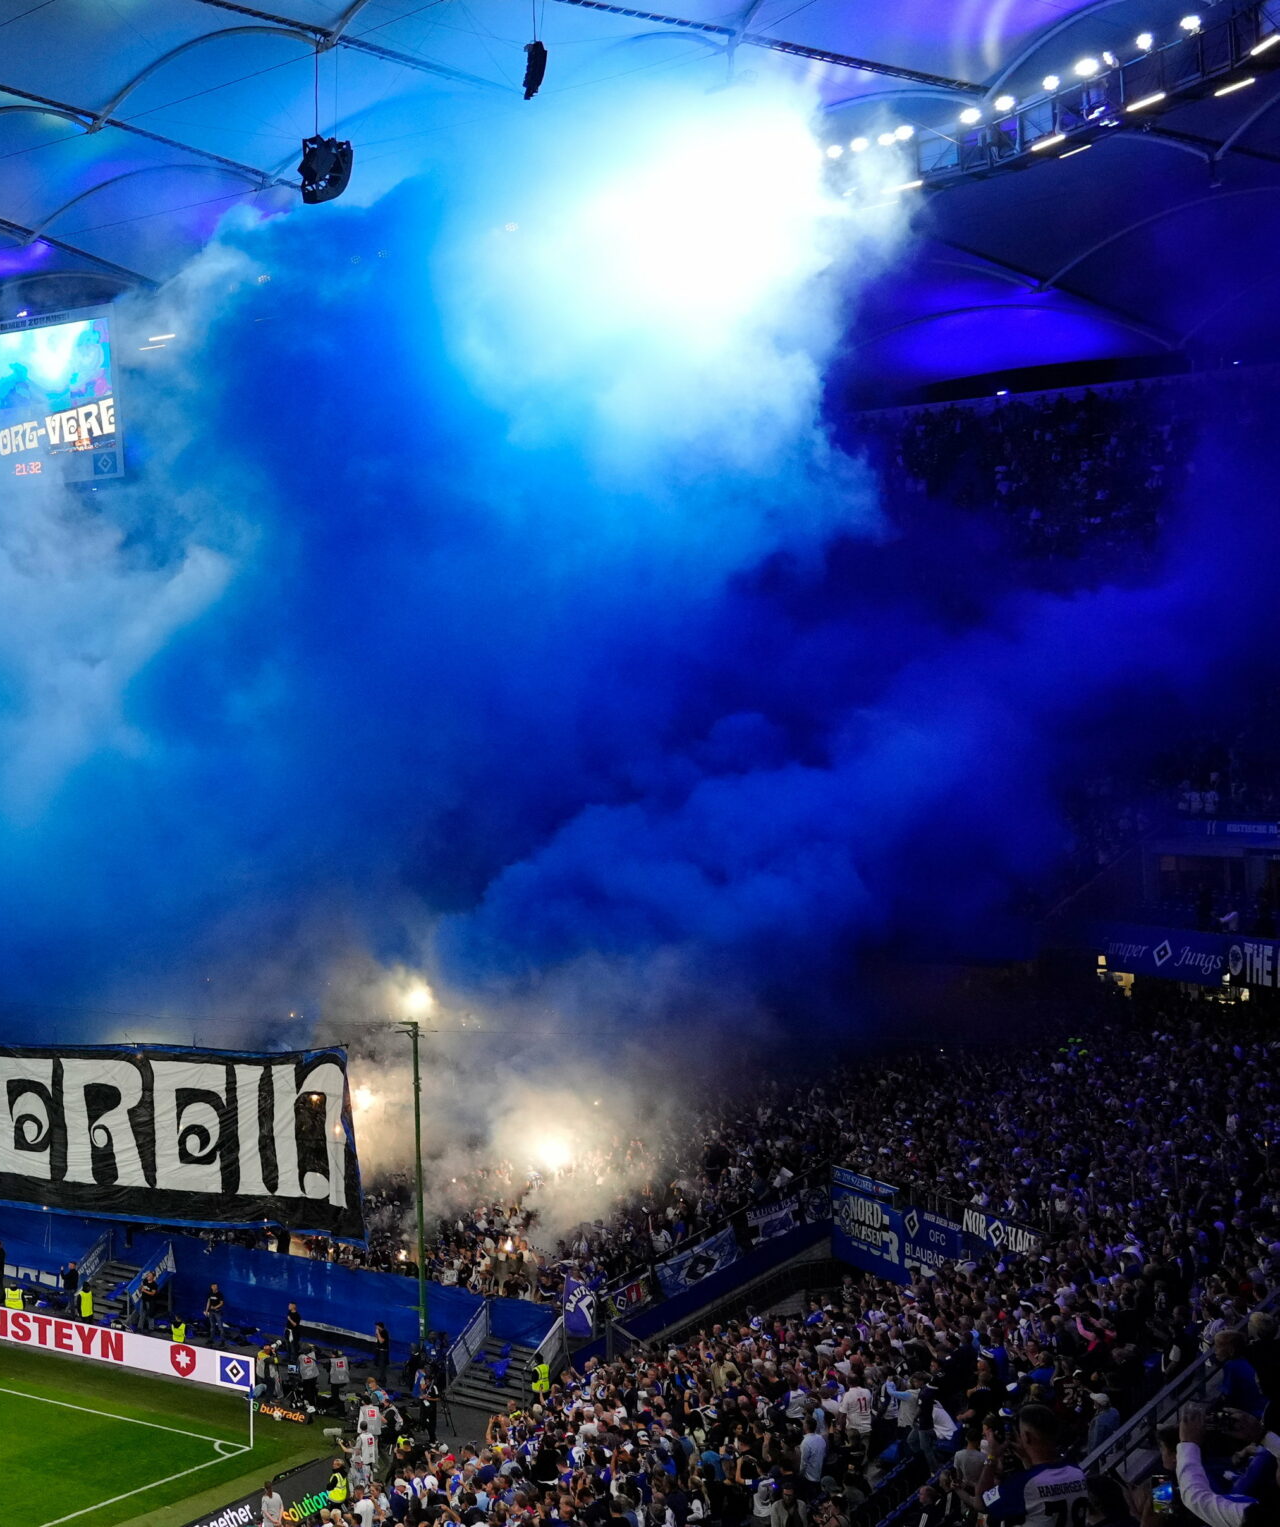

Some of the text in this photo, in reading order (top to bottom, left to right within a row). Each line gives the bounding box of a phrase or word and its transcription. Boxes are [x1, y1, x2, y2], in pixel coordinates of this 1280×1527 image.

[15, 462, 42, 476] 21:32
[1174, 945, 1224, 975] Jungs
[1243, 942, 1273, 987] THE
[928, 1229, 946, 1246] OFC
[259, 1403, 306, 1423] buXtrade
[857, 1396, 868, 1412] 11
